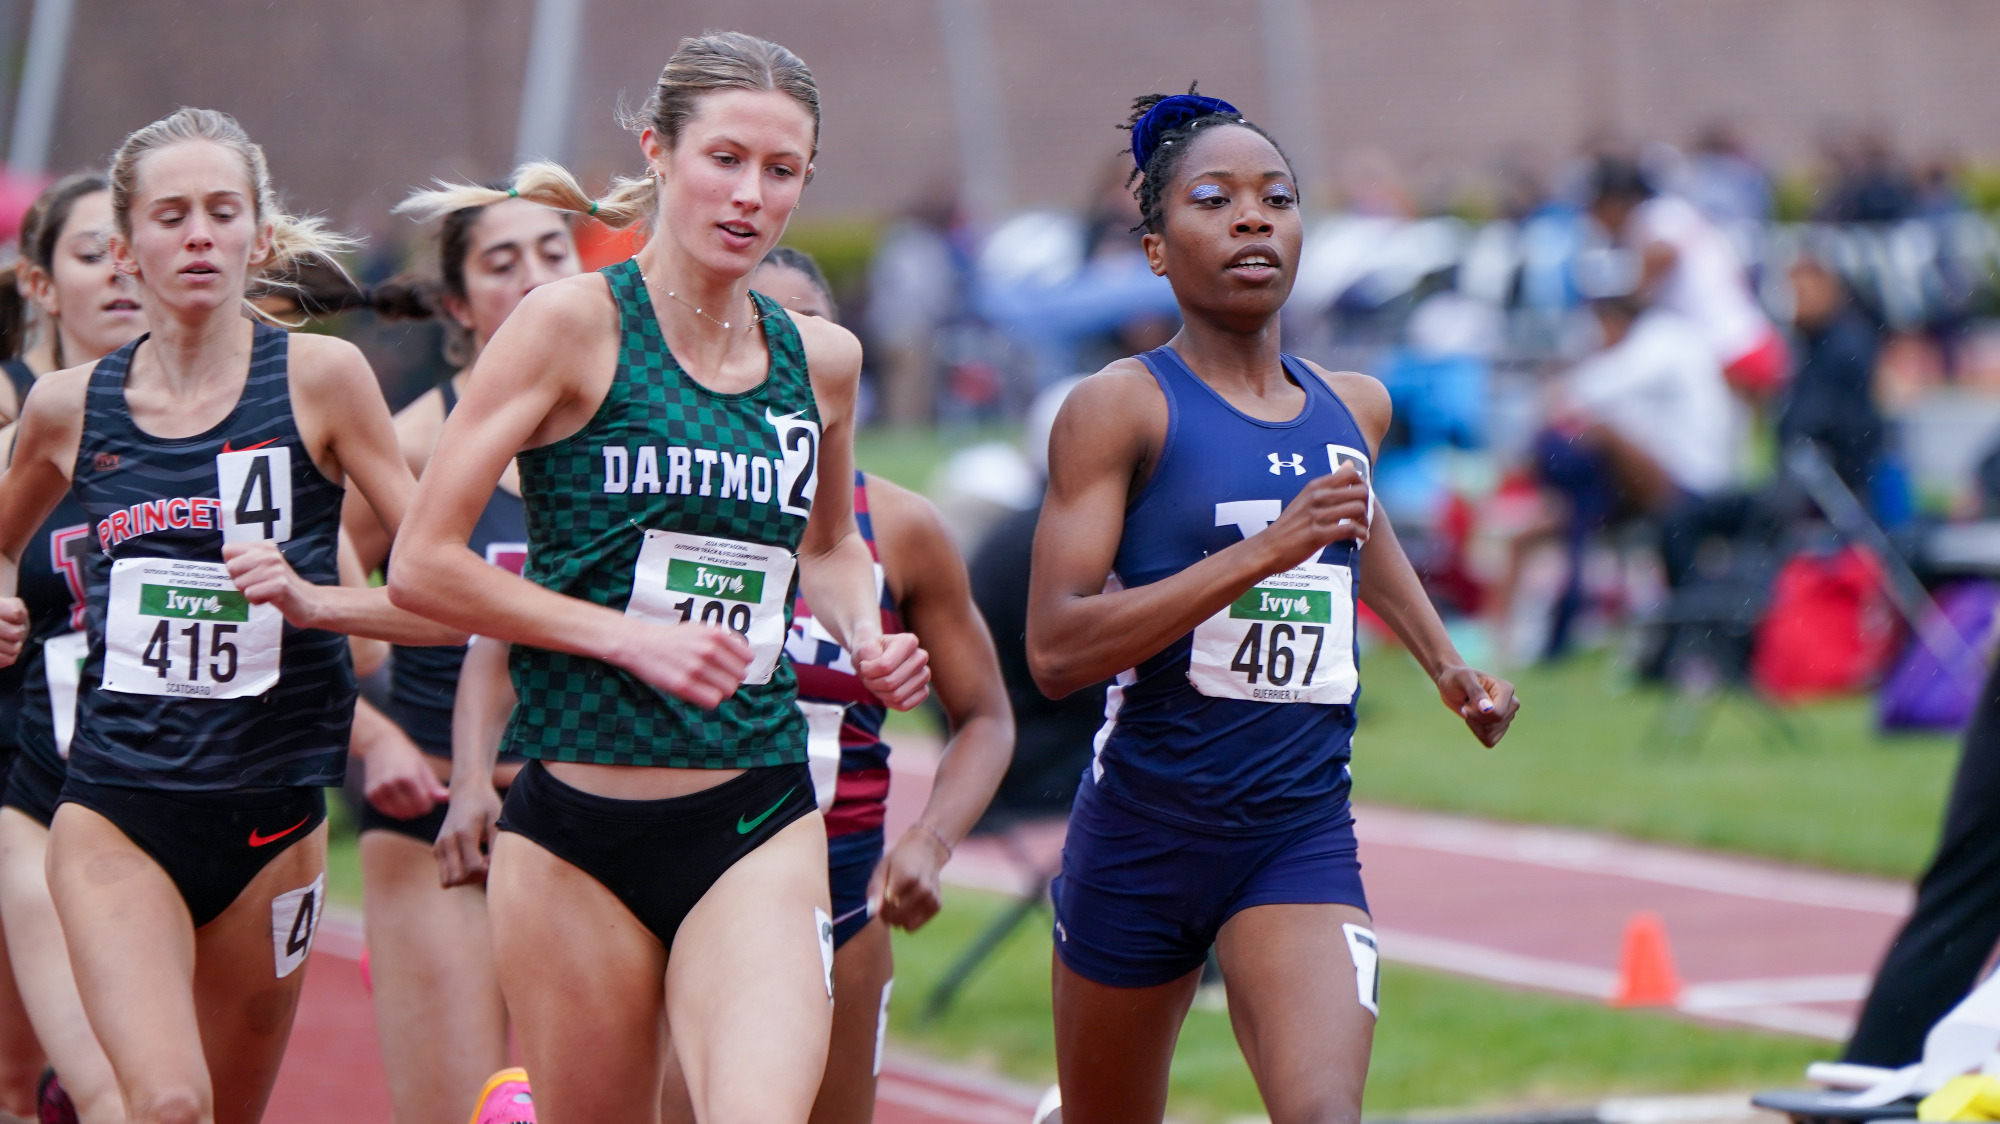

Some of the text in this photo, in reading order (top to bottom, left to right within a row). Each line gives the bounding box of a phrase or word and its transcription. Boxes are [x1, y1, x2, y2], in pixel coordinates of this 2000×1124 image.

[235, 455, 281, 539] 4
[602, 445, 784, 504] DARTMO
[786, 427, 814, 512] 2
[97, 497, 223, 550] PRINCET
[166, 590, 205, 616] Ivy
[694, 566, 731, 595] Ivy
[1259, 592, 1293, 618] Ivy
[142, 619, 238, 683] 415
[1230, 623, 1324, 687] 467
[286, 889, 315, 958] 4
